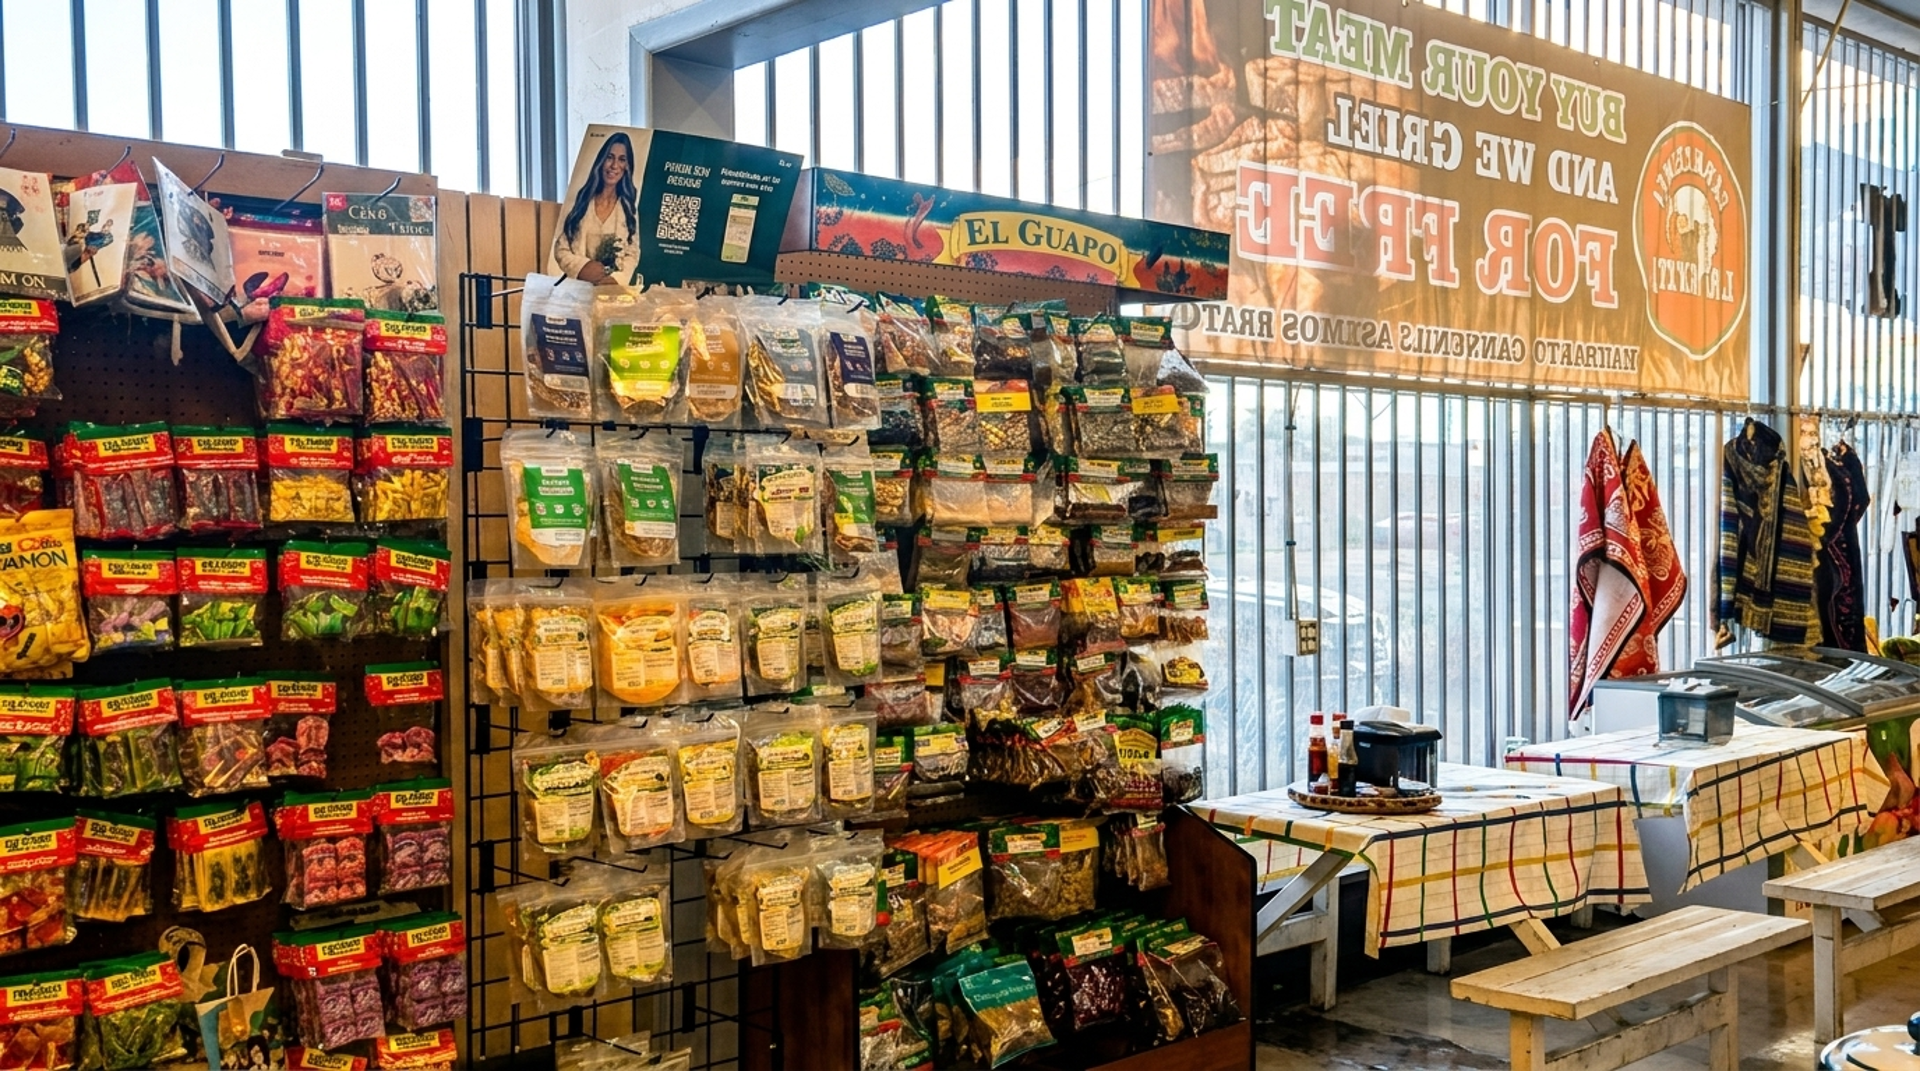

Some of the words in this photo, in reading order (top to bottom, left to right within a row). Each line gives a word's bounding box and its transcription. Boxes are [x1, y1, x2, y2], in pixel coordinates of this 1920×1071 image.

[965, 217, 1010, 246] EL
[1018, 219, 1118, 265] GUAPO
[22, 275, 46, 288] ON
